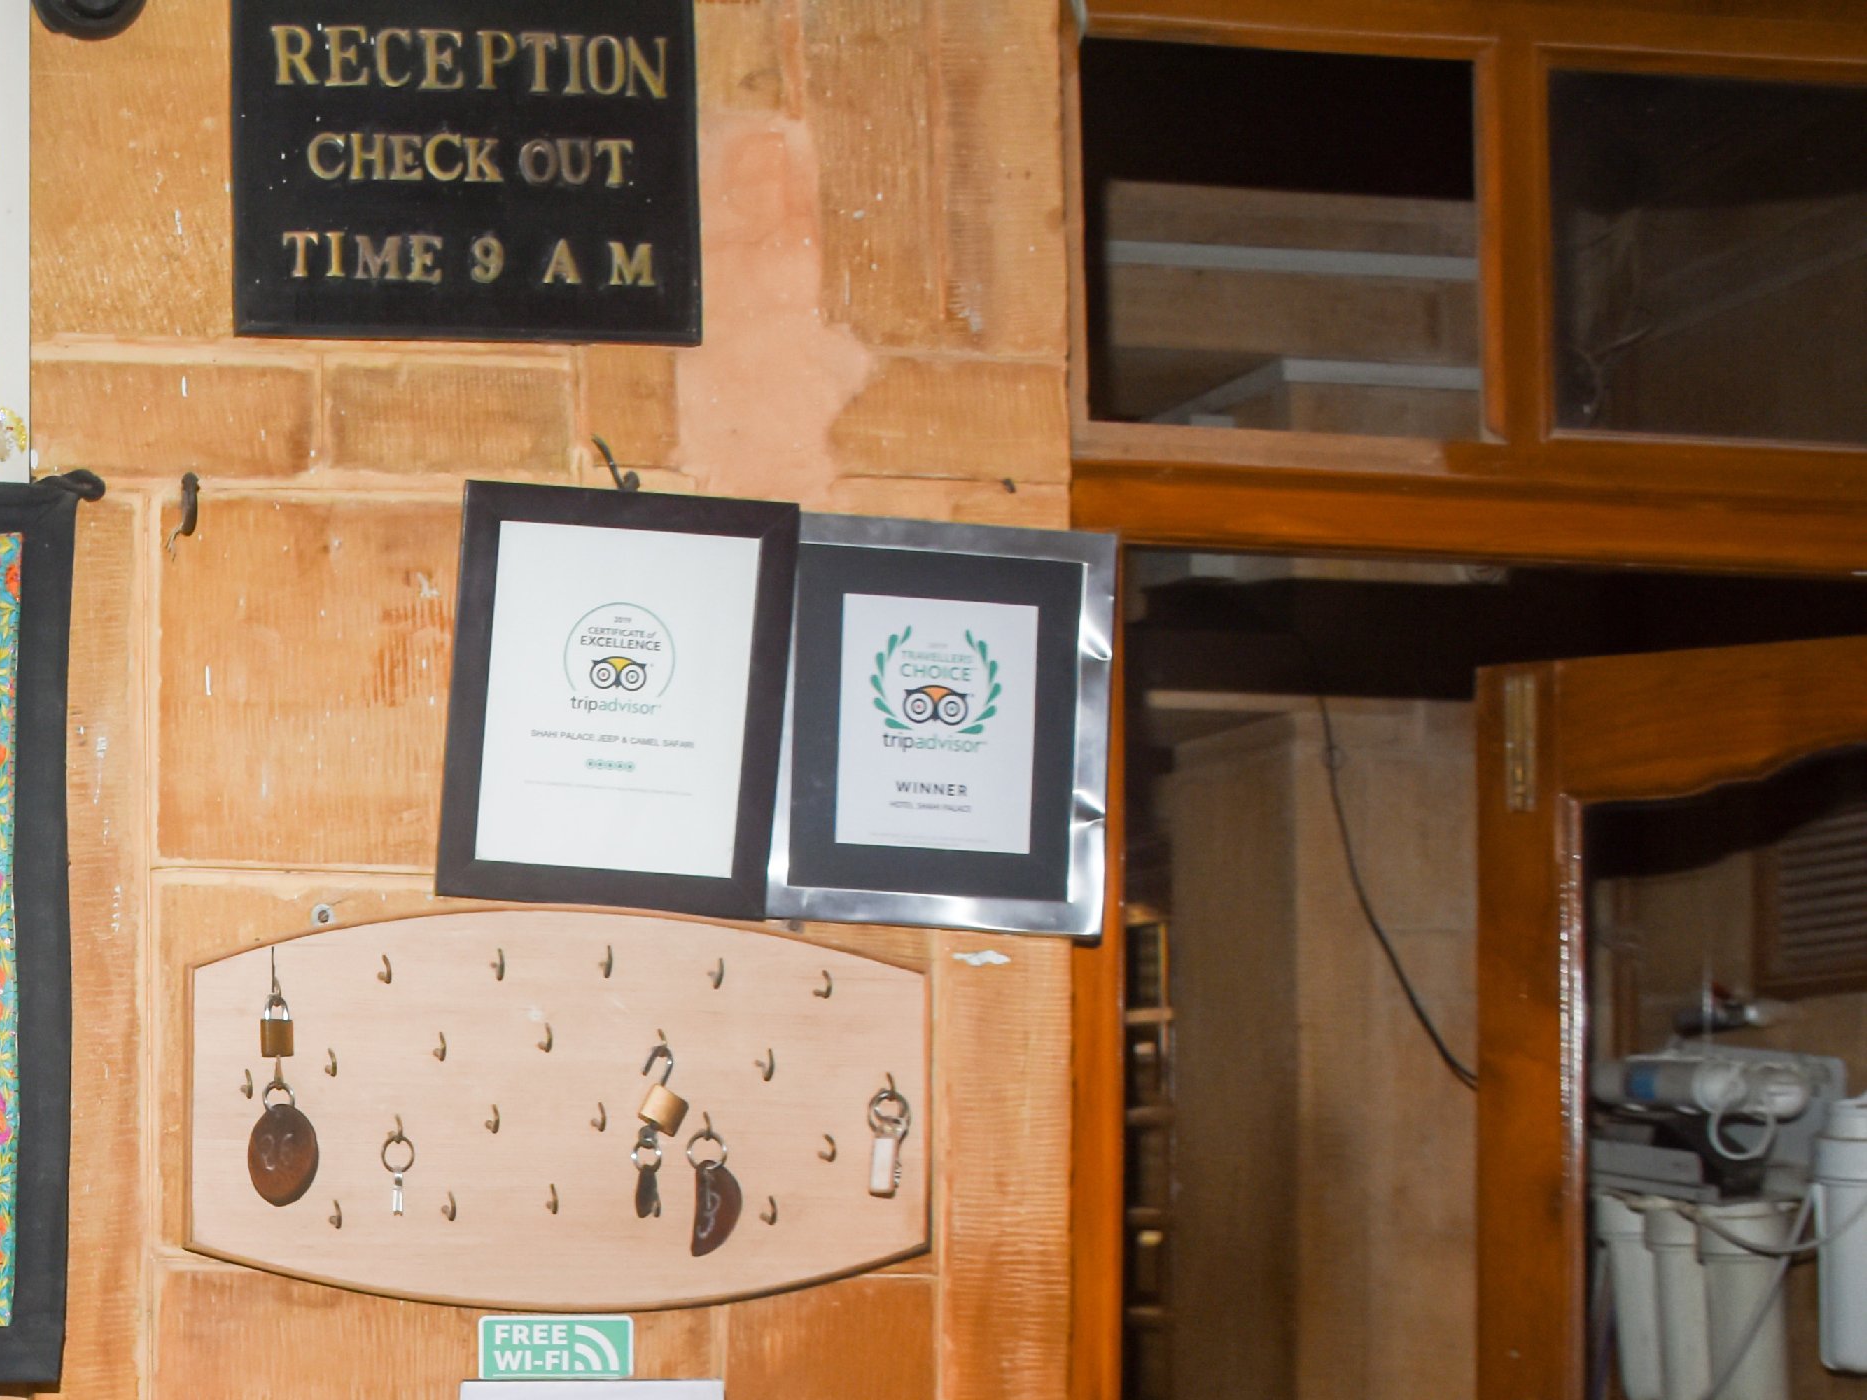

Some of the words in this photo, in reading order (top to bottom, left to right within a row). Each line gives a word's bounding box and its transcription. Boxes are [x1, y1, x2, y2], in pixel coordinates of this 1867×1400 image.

[271, 25, 667, 98] RECEPTION
[307, 133, 504, 183] CHECK
[520, 139, 633, 187] OUT
[283, 231, 443, 282] TIME
[470, 236, 504, 283] 9
[542, 239, 581, 284] A
[608, 242, 655, 286] M
[588, 626, 645, 638] CERTIFICATE
[580, 635, 662, 651] EXCELLENCE
[900, 663, 972, 681] CHOICE
[570, 696, 657, 714] tripadvisor
[531, 729, 558, 738] SHAHI
[560, 731, 595, 741] PALACE
[597, 734, 620, 743] JEEP
[630, 737, 660, 747] CAMEL
[883, 733, 980, 752] tripadvisor
[896, 781, 968, 796] WINNER
[494, 1324, 568, 1345] FREE
[494, 1350, 570, 1371] WI-FI
